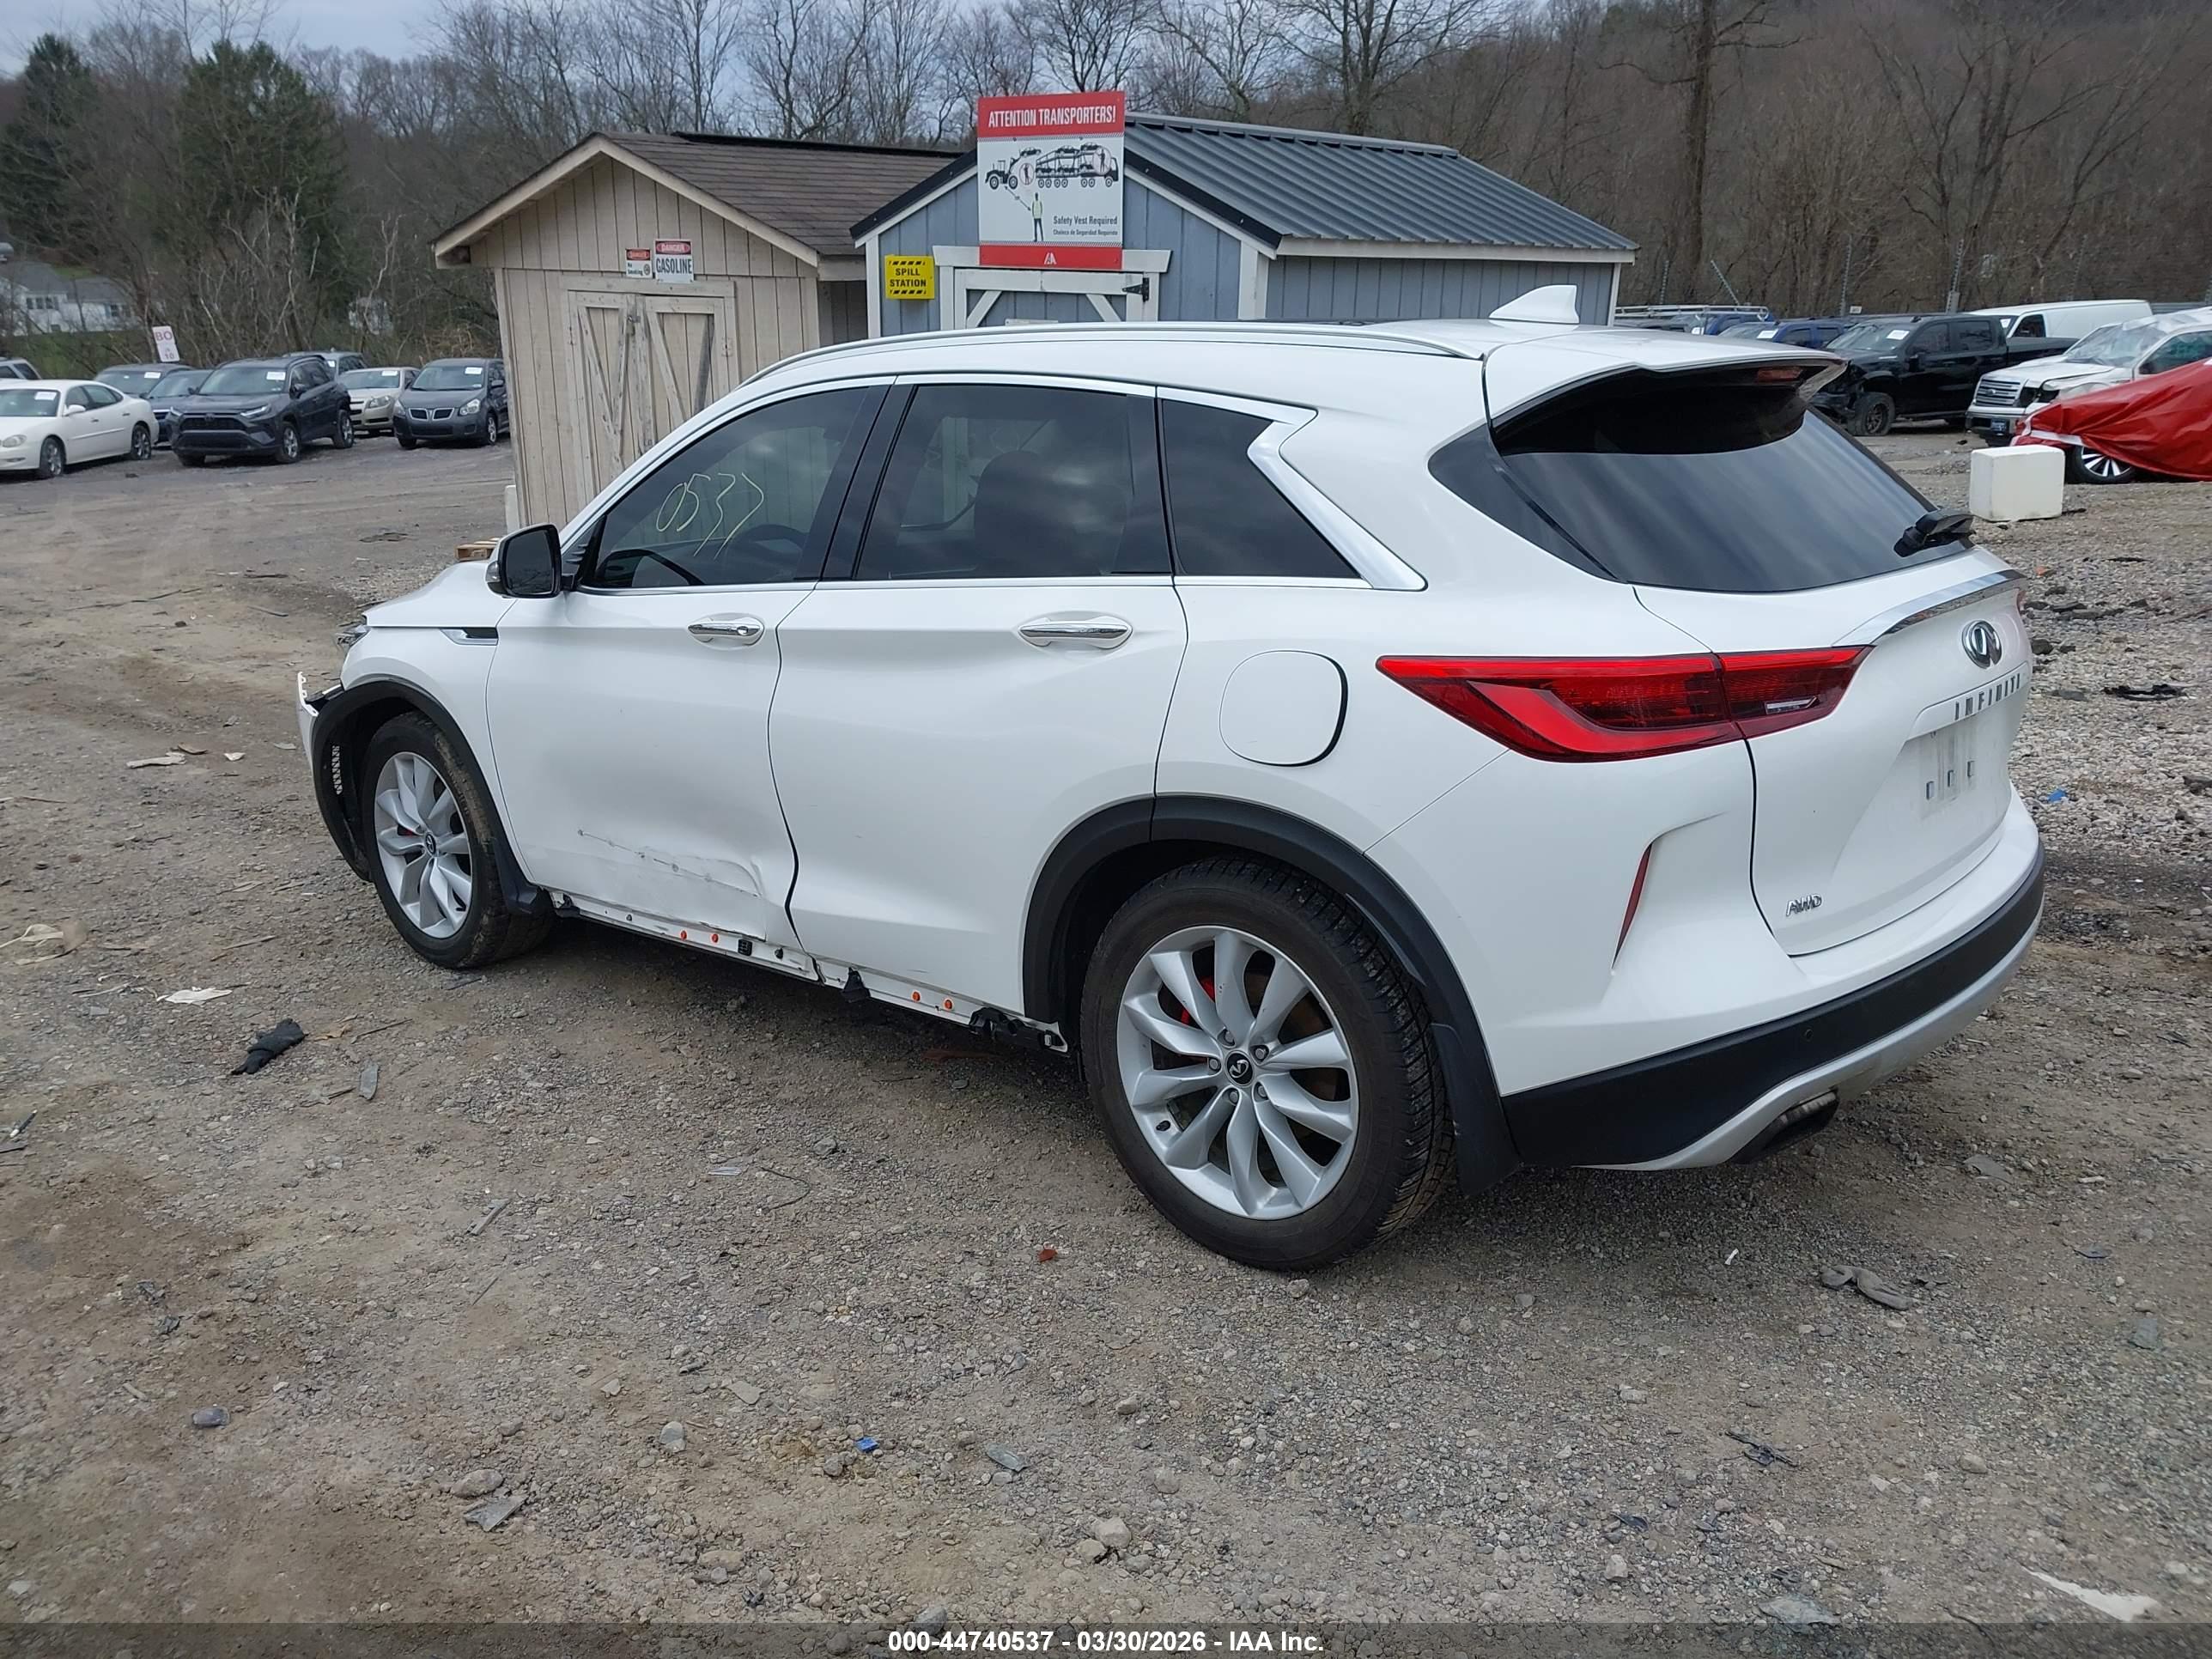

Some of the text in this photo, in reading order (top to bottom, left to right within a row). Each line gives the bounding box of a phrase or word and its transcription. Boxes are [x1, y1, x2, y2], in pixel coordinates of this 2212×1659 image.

[988, 105, 1117, 128] ATTENTION TRANSPORTERS!
[1053, 215, 1118, 227] Safety Vest Required
[655, 258, 693, 274] GASOLINE
[895, 268, 921, 276] SPILL
[890, 278, 927, 288] STATION
[656, 472, 764, 560] 0537
[1954, 672, 2021, 721] INFINITI
[1786, 894, 1822, 917] AWD
